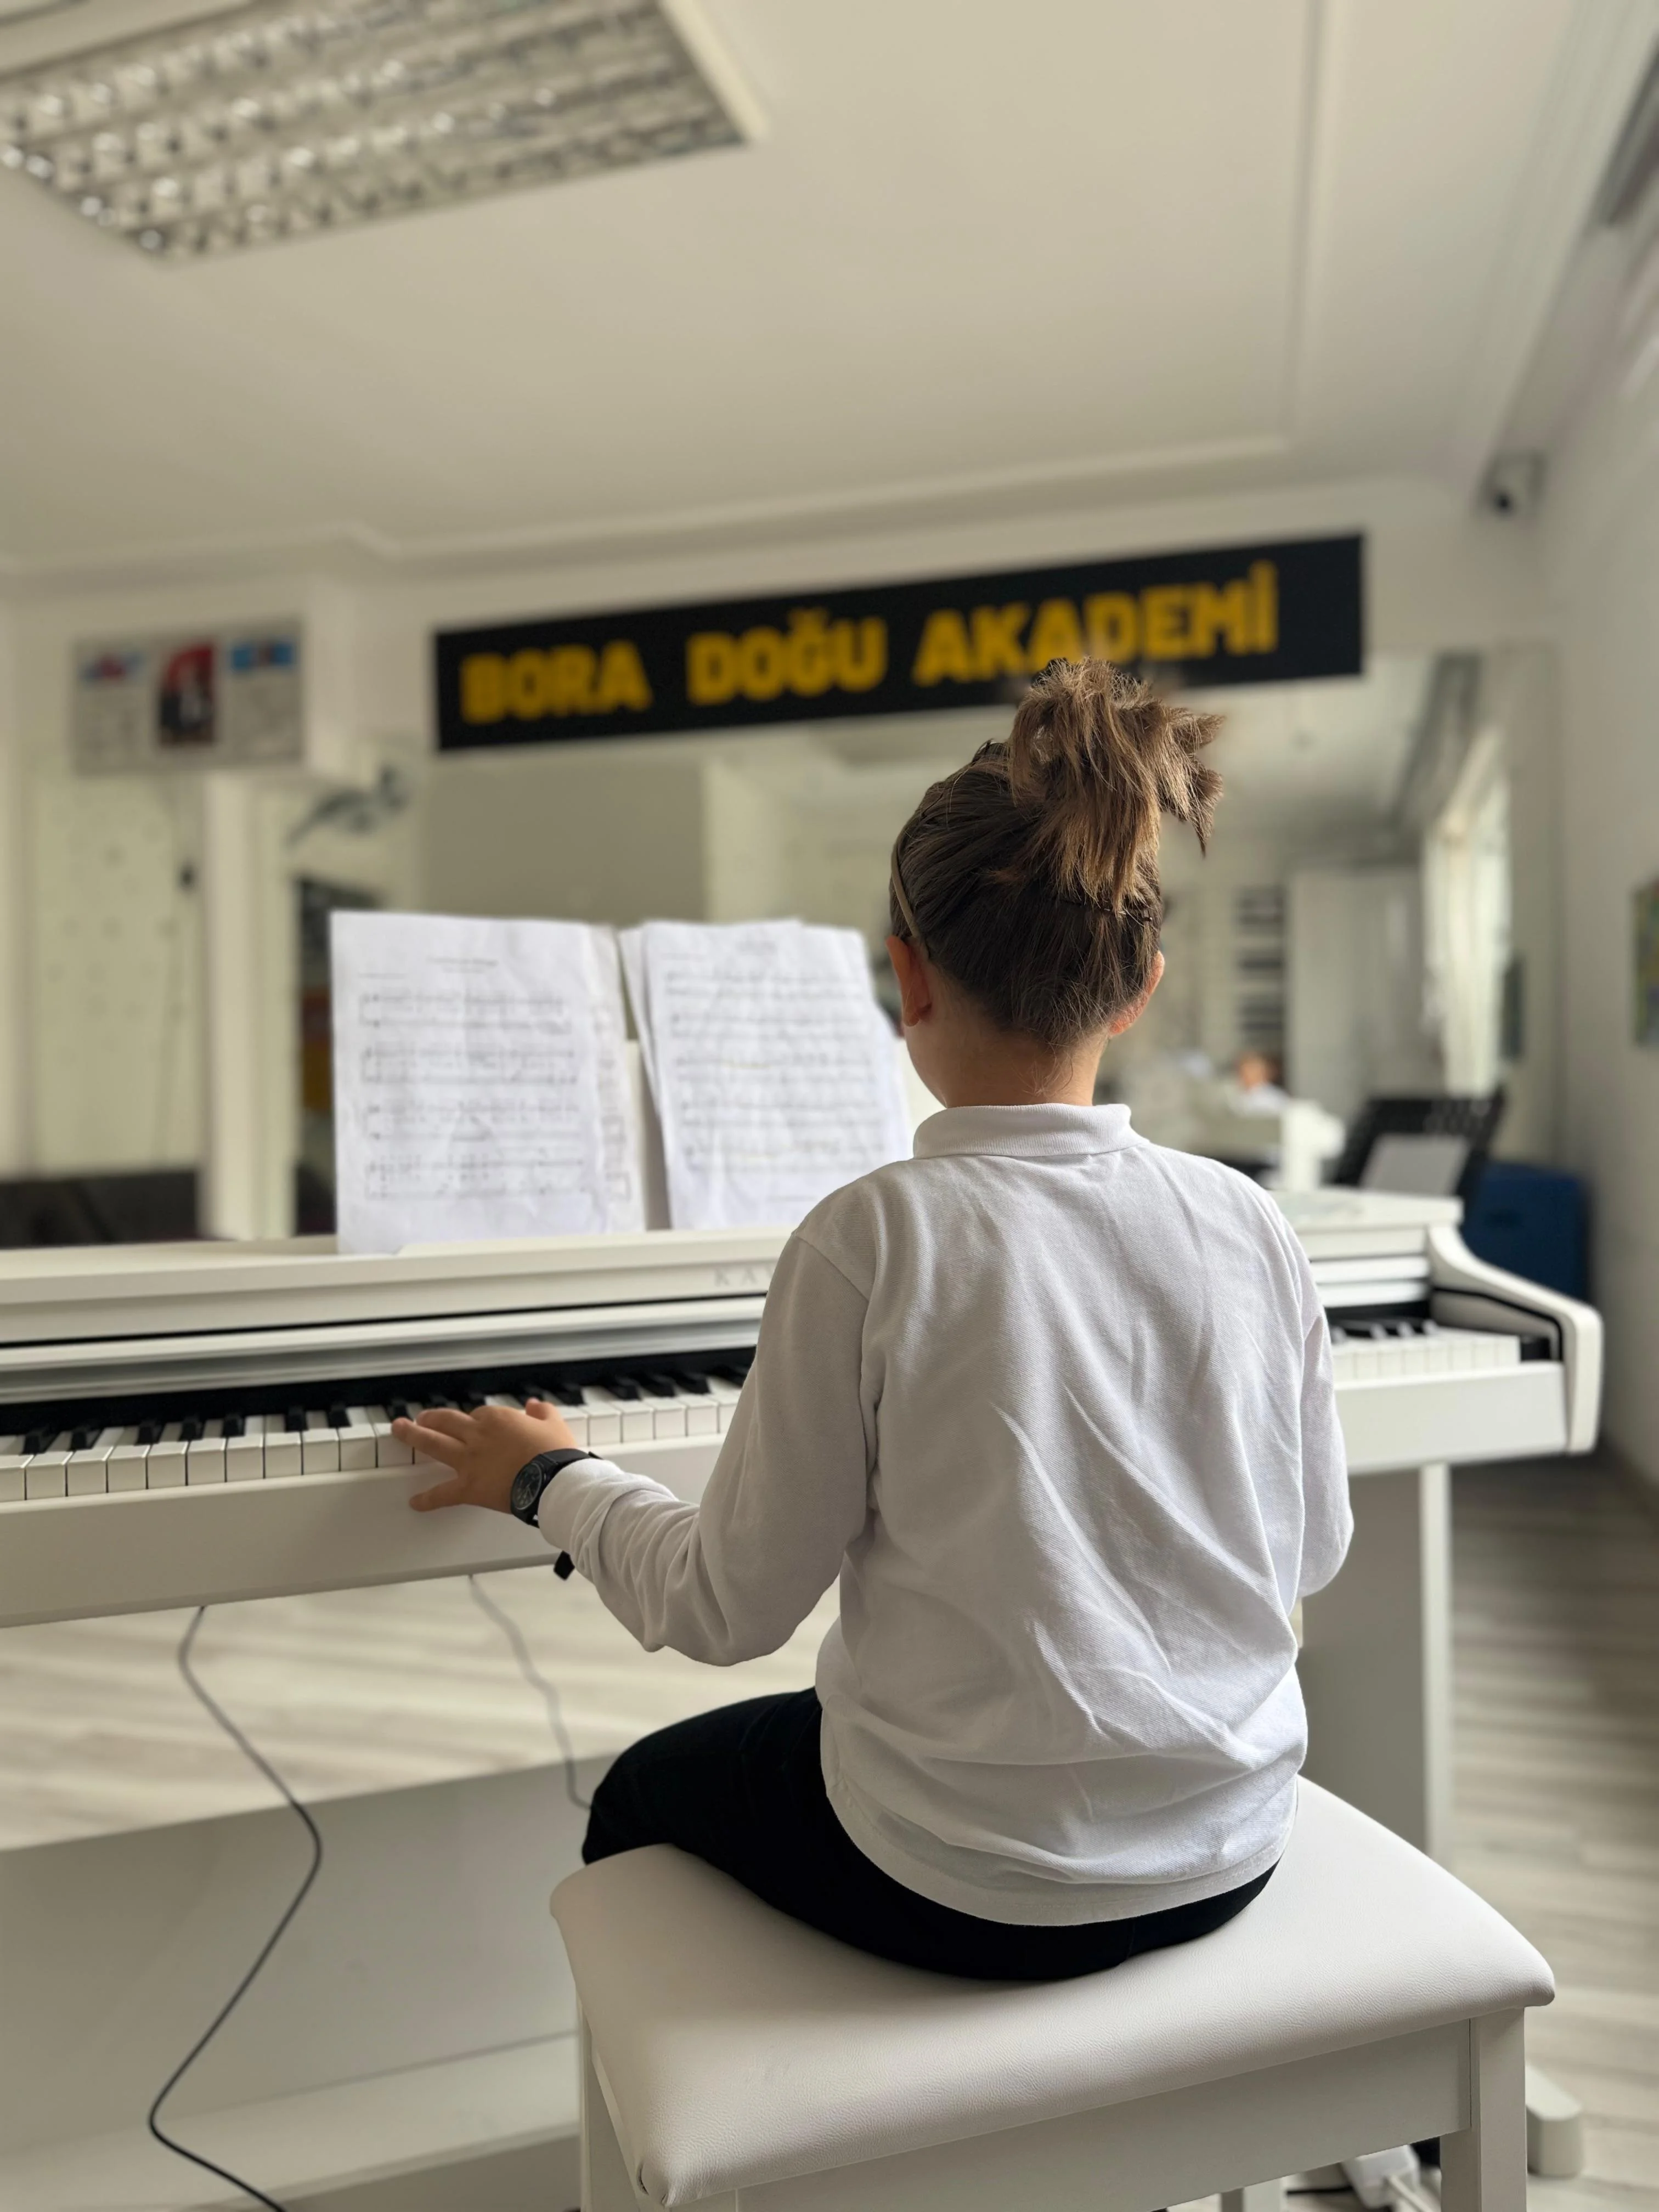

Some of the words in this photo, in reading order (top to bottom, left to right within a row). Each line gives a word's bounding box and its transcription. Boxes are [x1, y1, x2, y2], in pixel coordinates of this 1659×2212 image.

[464, 644, 650, 720] BORA
[688, 611, 885, 703] DOĞU
[914, 563, 1277, 684] AKADEMİ
